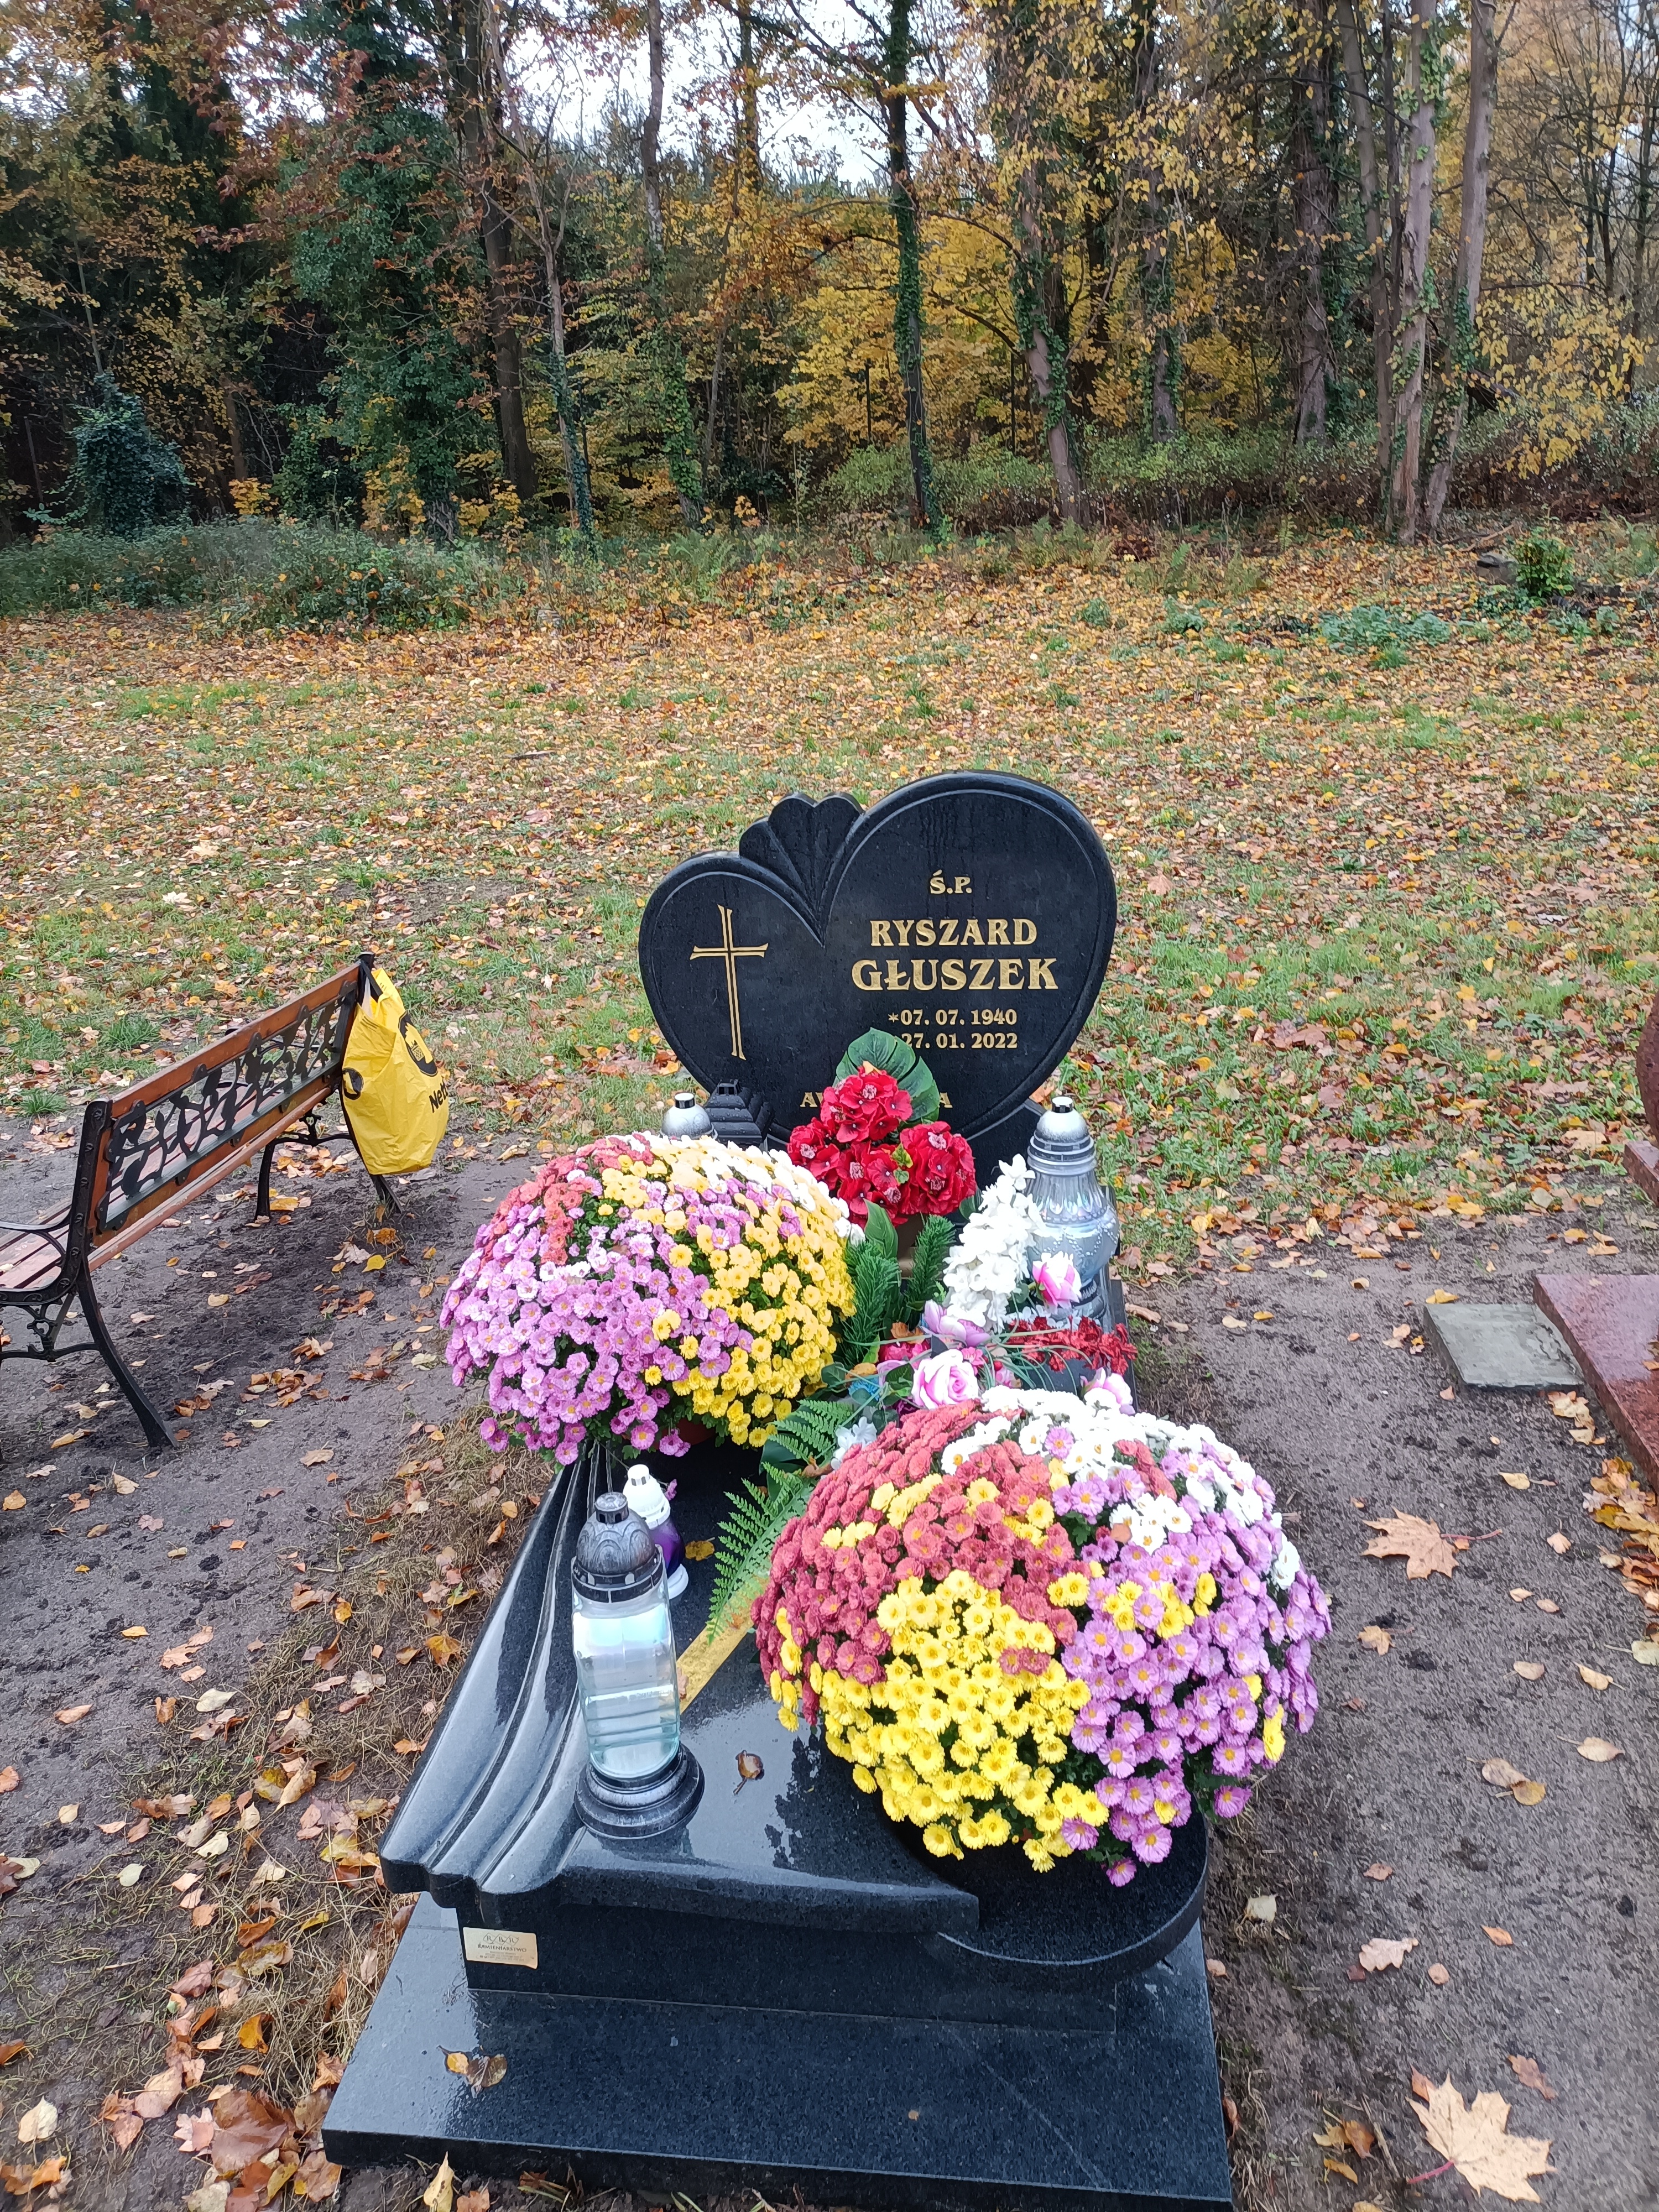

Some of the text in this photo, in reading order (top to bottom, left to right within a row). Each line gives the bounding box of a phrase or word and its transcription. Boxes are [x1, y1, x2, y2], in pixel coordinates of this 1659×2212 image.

[930, 869, 972, 894] Ś.P.
[870, 918, 1038, 947] RYSZARD
[852, 958, 1058, 990] GŁUSZEK
[935, 1009, 966, 1025] 07.
[971, 1008, 1018, 1025] 1940
[936, 1032, 966, 1048] 01.
[971, 1032, 1018, 1048] 2022
[477, 1943, 527, 1952] KAMIENIARSTWO
